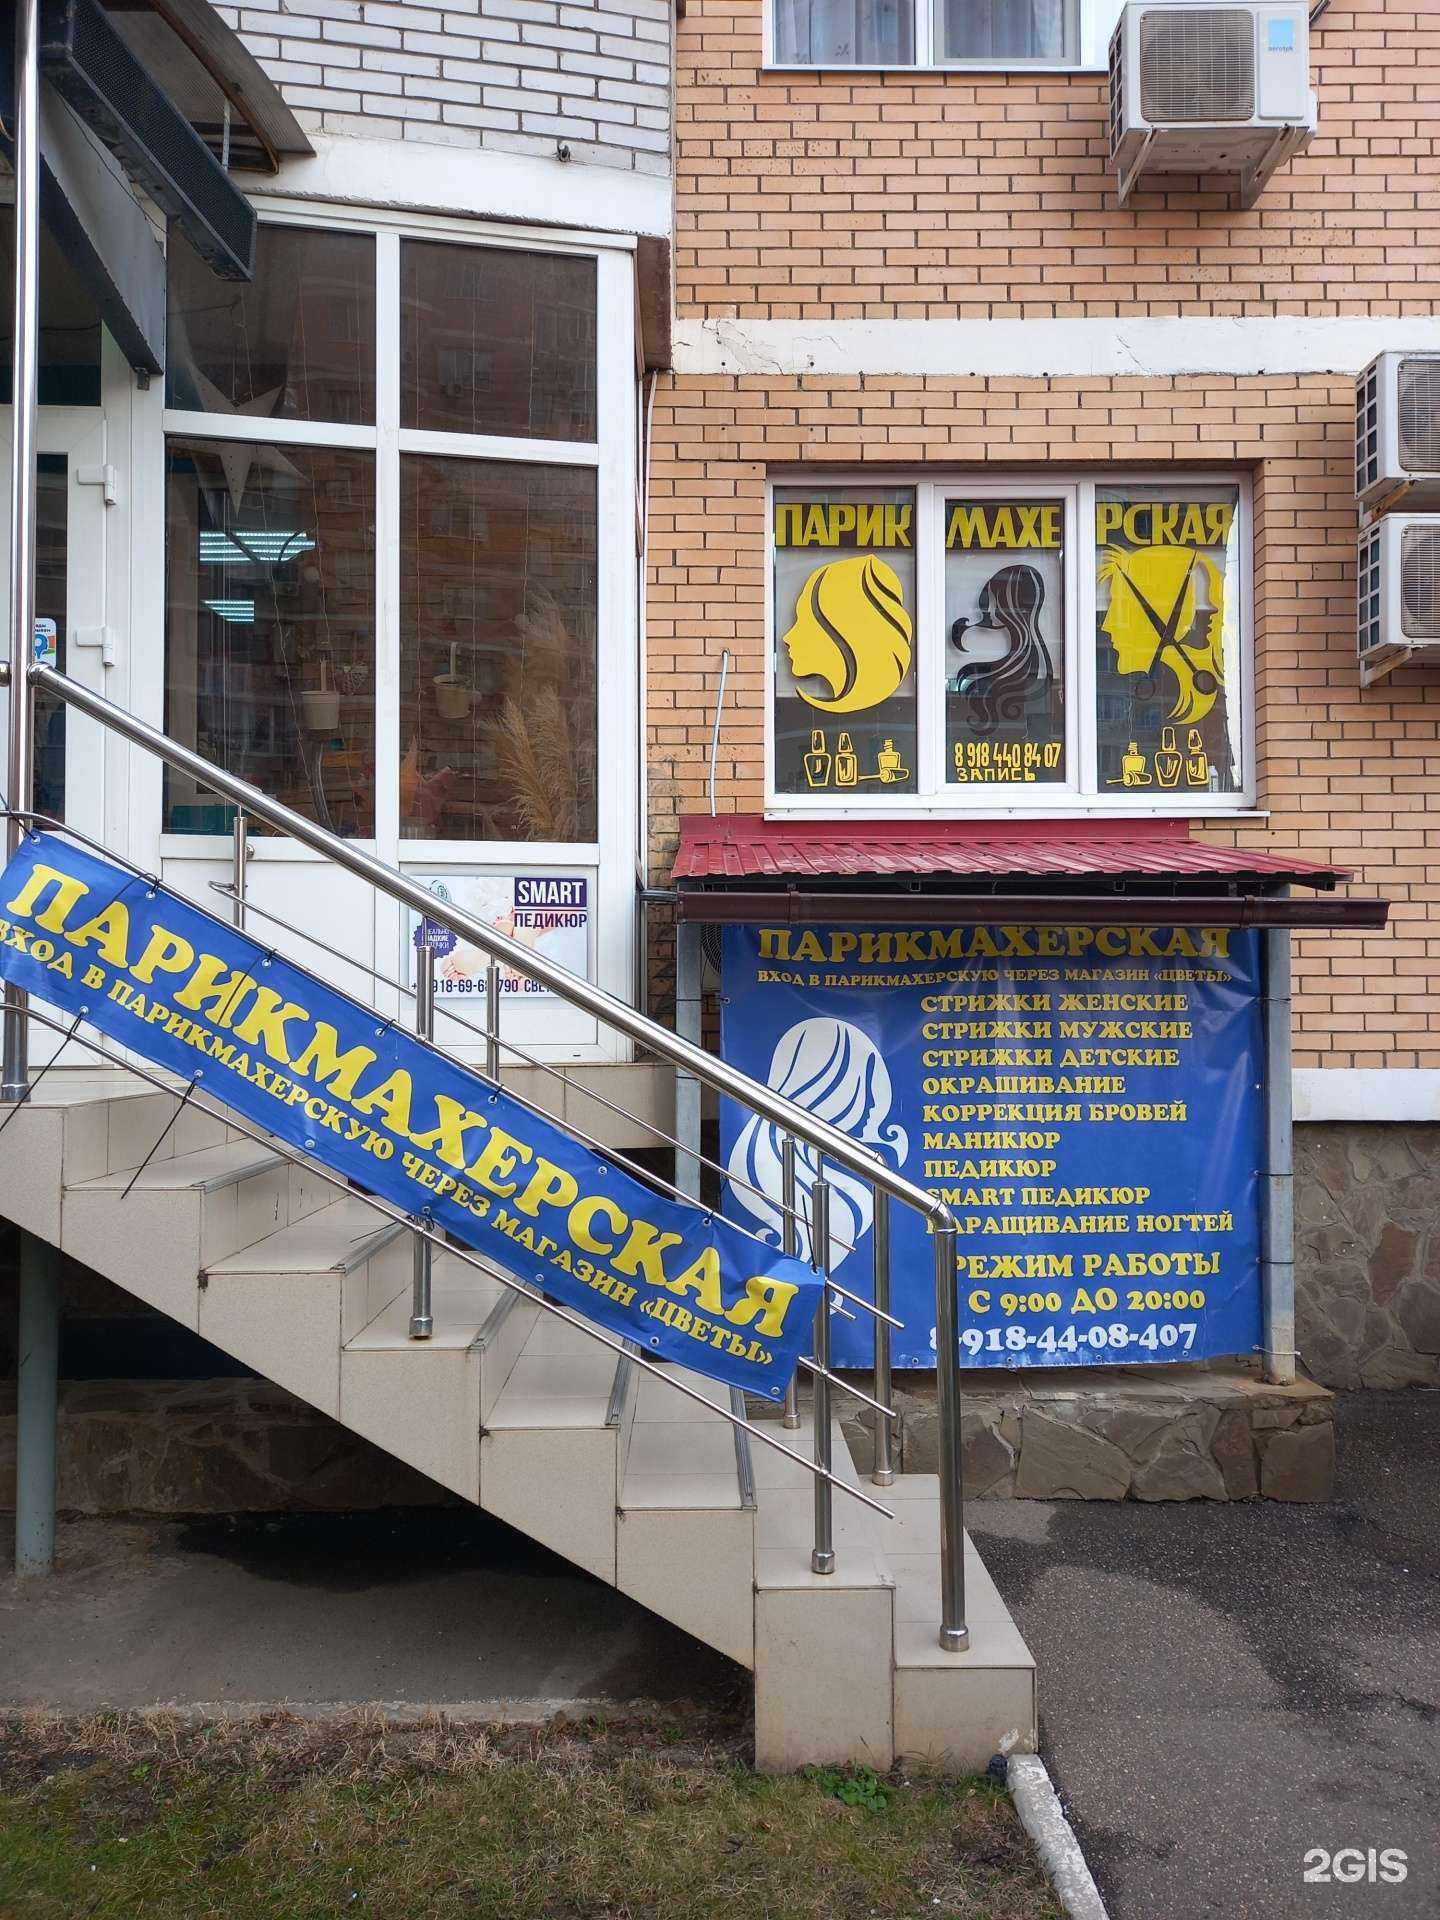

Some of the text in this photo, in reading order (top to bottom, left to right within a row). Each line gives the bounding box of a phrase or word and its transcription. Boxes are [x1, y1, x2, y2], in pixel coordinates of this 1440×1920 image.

[775, 502, 1233, 548] ПАРИК МАХЕ РСКАЯ
[955, 742, 1062, 768] 8 918 440 84 07
[956, 767, 1036, 782] ЗАПИСЬ
[517, 880, 584, 904] SMART
[514, 912, 587, 929] ПЕДИКЮР
[758, 926, 1230, 963] ПАРИКМАХЕРСКАЯ
[758, 968, 1232, 987] ВХОД В ПАРИКМАХЕРСКУЮ ЧЕРЕЗ МАГАЗИН «ЦВЕТЫ»
[921, 994, 1189, 1013] СТРИЖКИ ЖЕНСКИЕ
[922, 1021, 1193, 1040] СТРИЖКИ МУЖСКИЕ
[922, 1049, 1180, 1068] СТРИЖКИ ДЕТСКИЕ
[922, 1076, 1126, 1095] ОКРАШИВАНИЕ
[7, 863, 799, 1338] ПАРИКМАХЕРСКАЯ
[923, 1100, 1188, 1123] КОРРЕКЦИЯ БРОВЕЙ
[923, 1131, 1061, 1150] МАНИКЮР
[81, 963, 106, 990] В
[107, 979, 394, 1160] ПАРИКМАХЕРСКУЮ
[402, 1151, 491, 1217] ЧЕРЕЗ
[491, 1209, 638, 1307] МАГАЗИН
[639, 1297, 773, 1365] «ЦВЕТЫ»
[924, 1159, 1057, 1179] ПЕДИКЮР
[1021, 1187, 1151, 1207] ПЕДИКЮР
[1136, 1210, 1234, 1233] НОГТЕЙ
[1082, 1251, 1221, 1277] РАБОТЫ
[968, 1287, 1206, 1316] С 9:00 ДО 20:00
